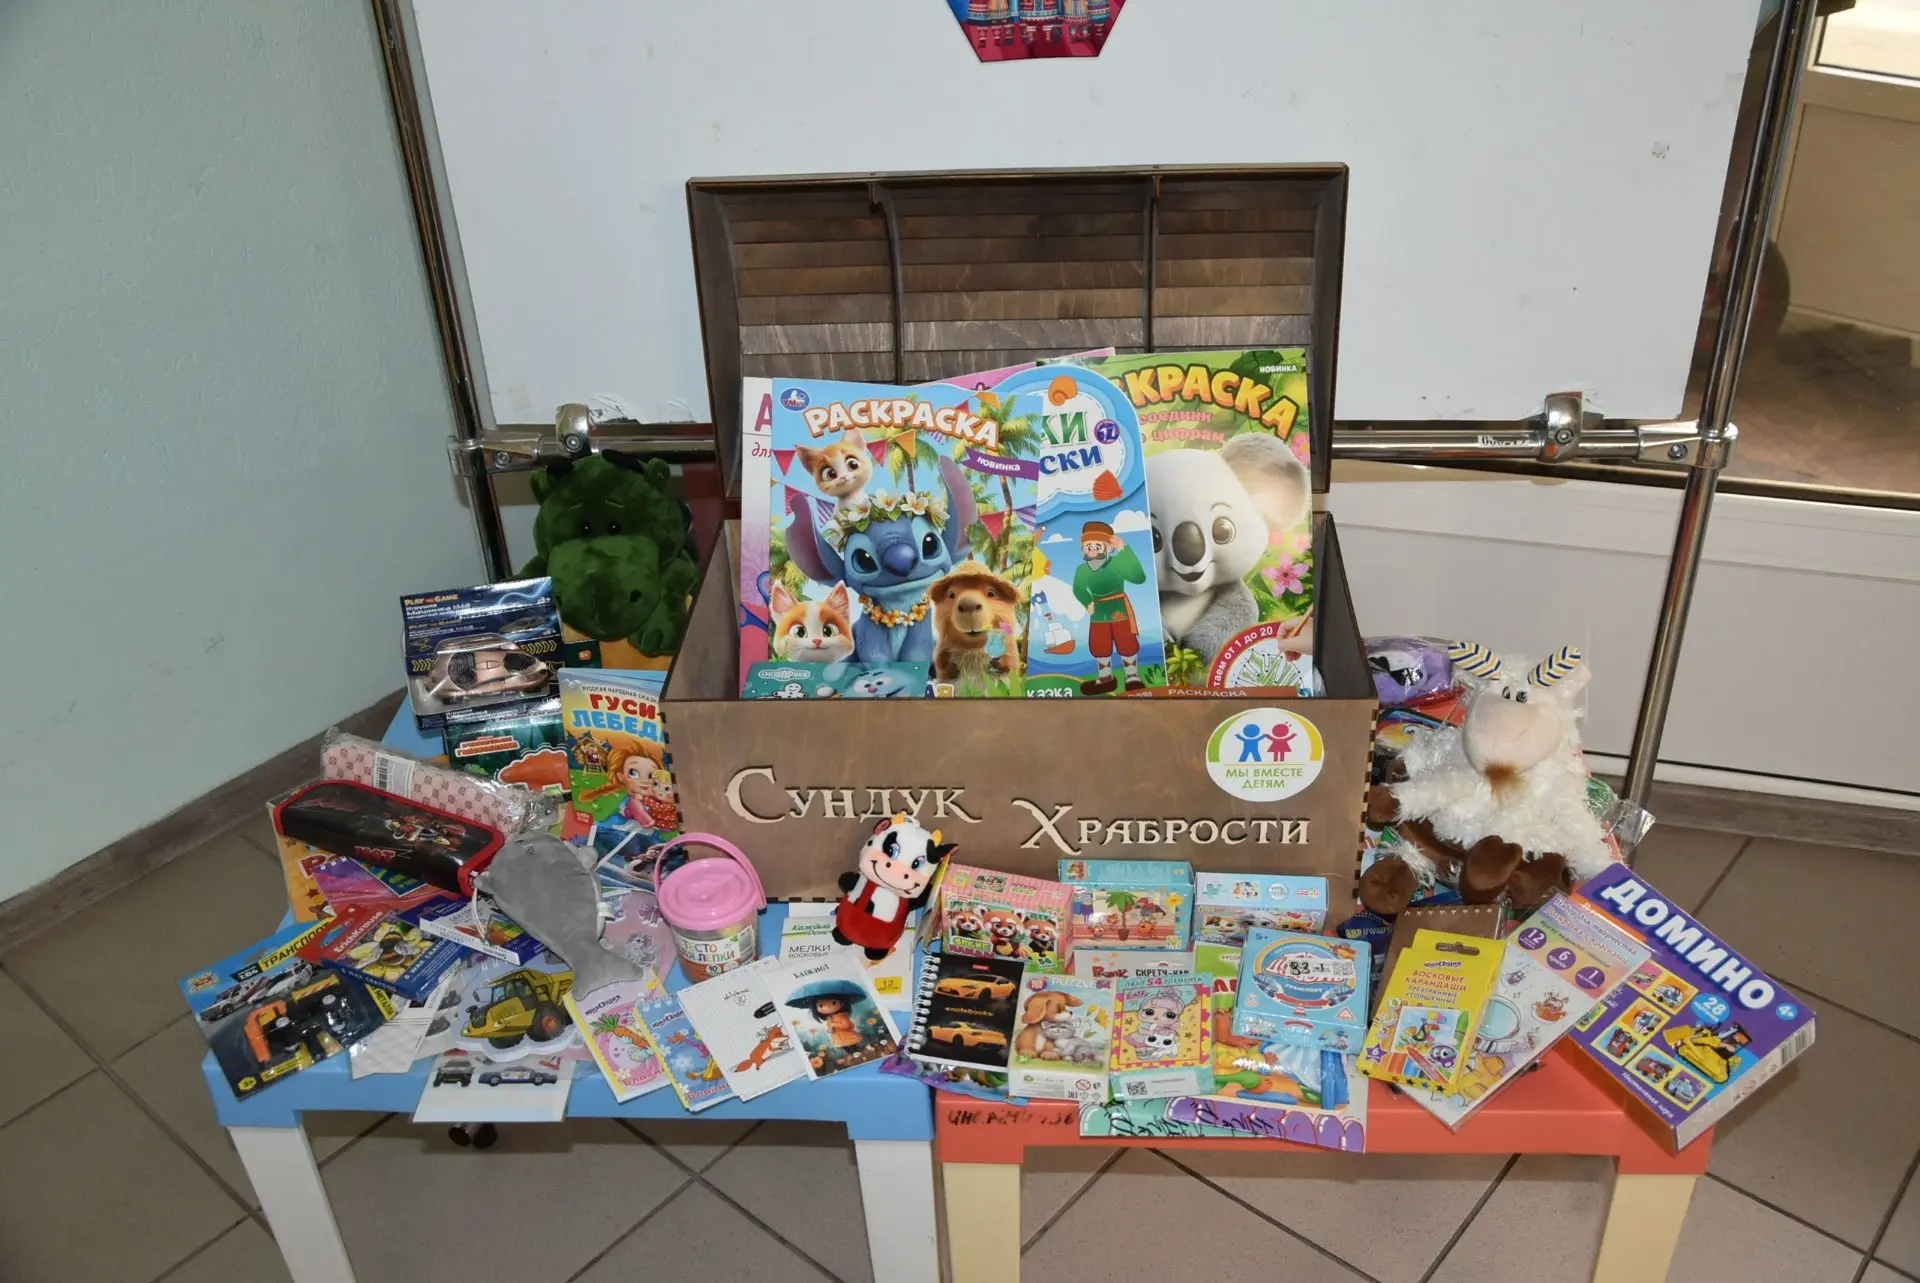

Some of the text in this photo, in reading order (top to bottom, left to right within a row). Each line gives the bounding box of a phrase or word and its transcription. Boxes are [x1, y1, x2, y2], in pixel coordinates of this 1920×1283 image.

[1259, 364, 1298, 374] НОВИНКА
[1110, 363, 1300, 440] КРАСКА
[803, 400, 1000, 449] РАСКРАСКА
[404, 594, 459, 606] PLAY GAME
[1224, 646, 1237, 660] от
[1244, 632, 1258, 644] до
[1260, 626, 1273, 637] 20
[1168, 688, 1247, 698] РАСКРАСКА
[572, 709, 664, 744] ЛЕБЕД
[1225, 767, 1304, 778] МЫ ВМЕСТЕ
[1242, 779, 1285, 790] ДЕТЯМ
[334, 911, 383, 953] ErichKrause
[1527, 928, 1544, 944] 12
[789, 944, 831, 953] МЕЛКИ
[1600, 878, 1775, 1009] ДОМИНО
[697, 950, 735, 962] ЛЕПКИ
[1559, 950, 1571, 961] 6
[709, 965, 718, 973] 10
[1147, 977, 1163, 986] 54
[1413, 970, 1465, 983] ВОСКОВЫЕ
[1405, 977, 1467, 992] КАРАНДАШИ
[1702, 996, 1727, 1016] 28
[1777, 1005, 1796, 1018] 4+
